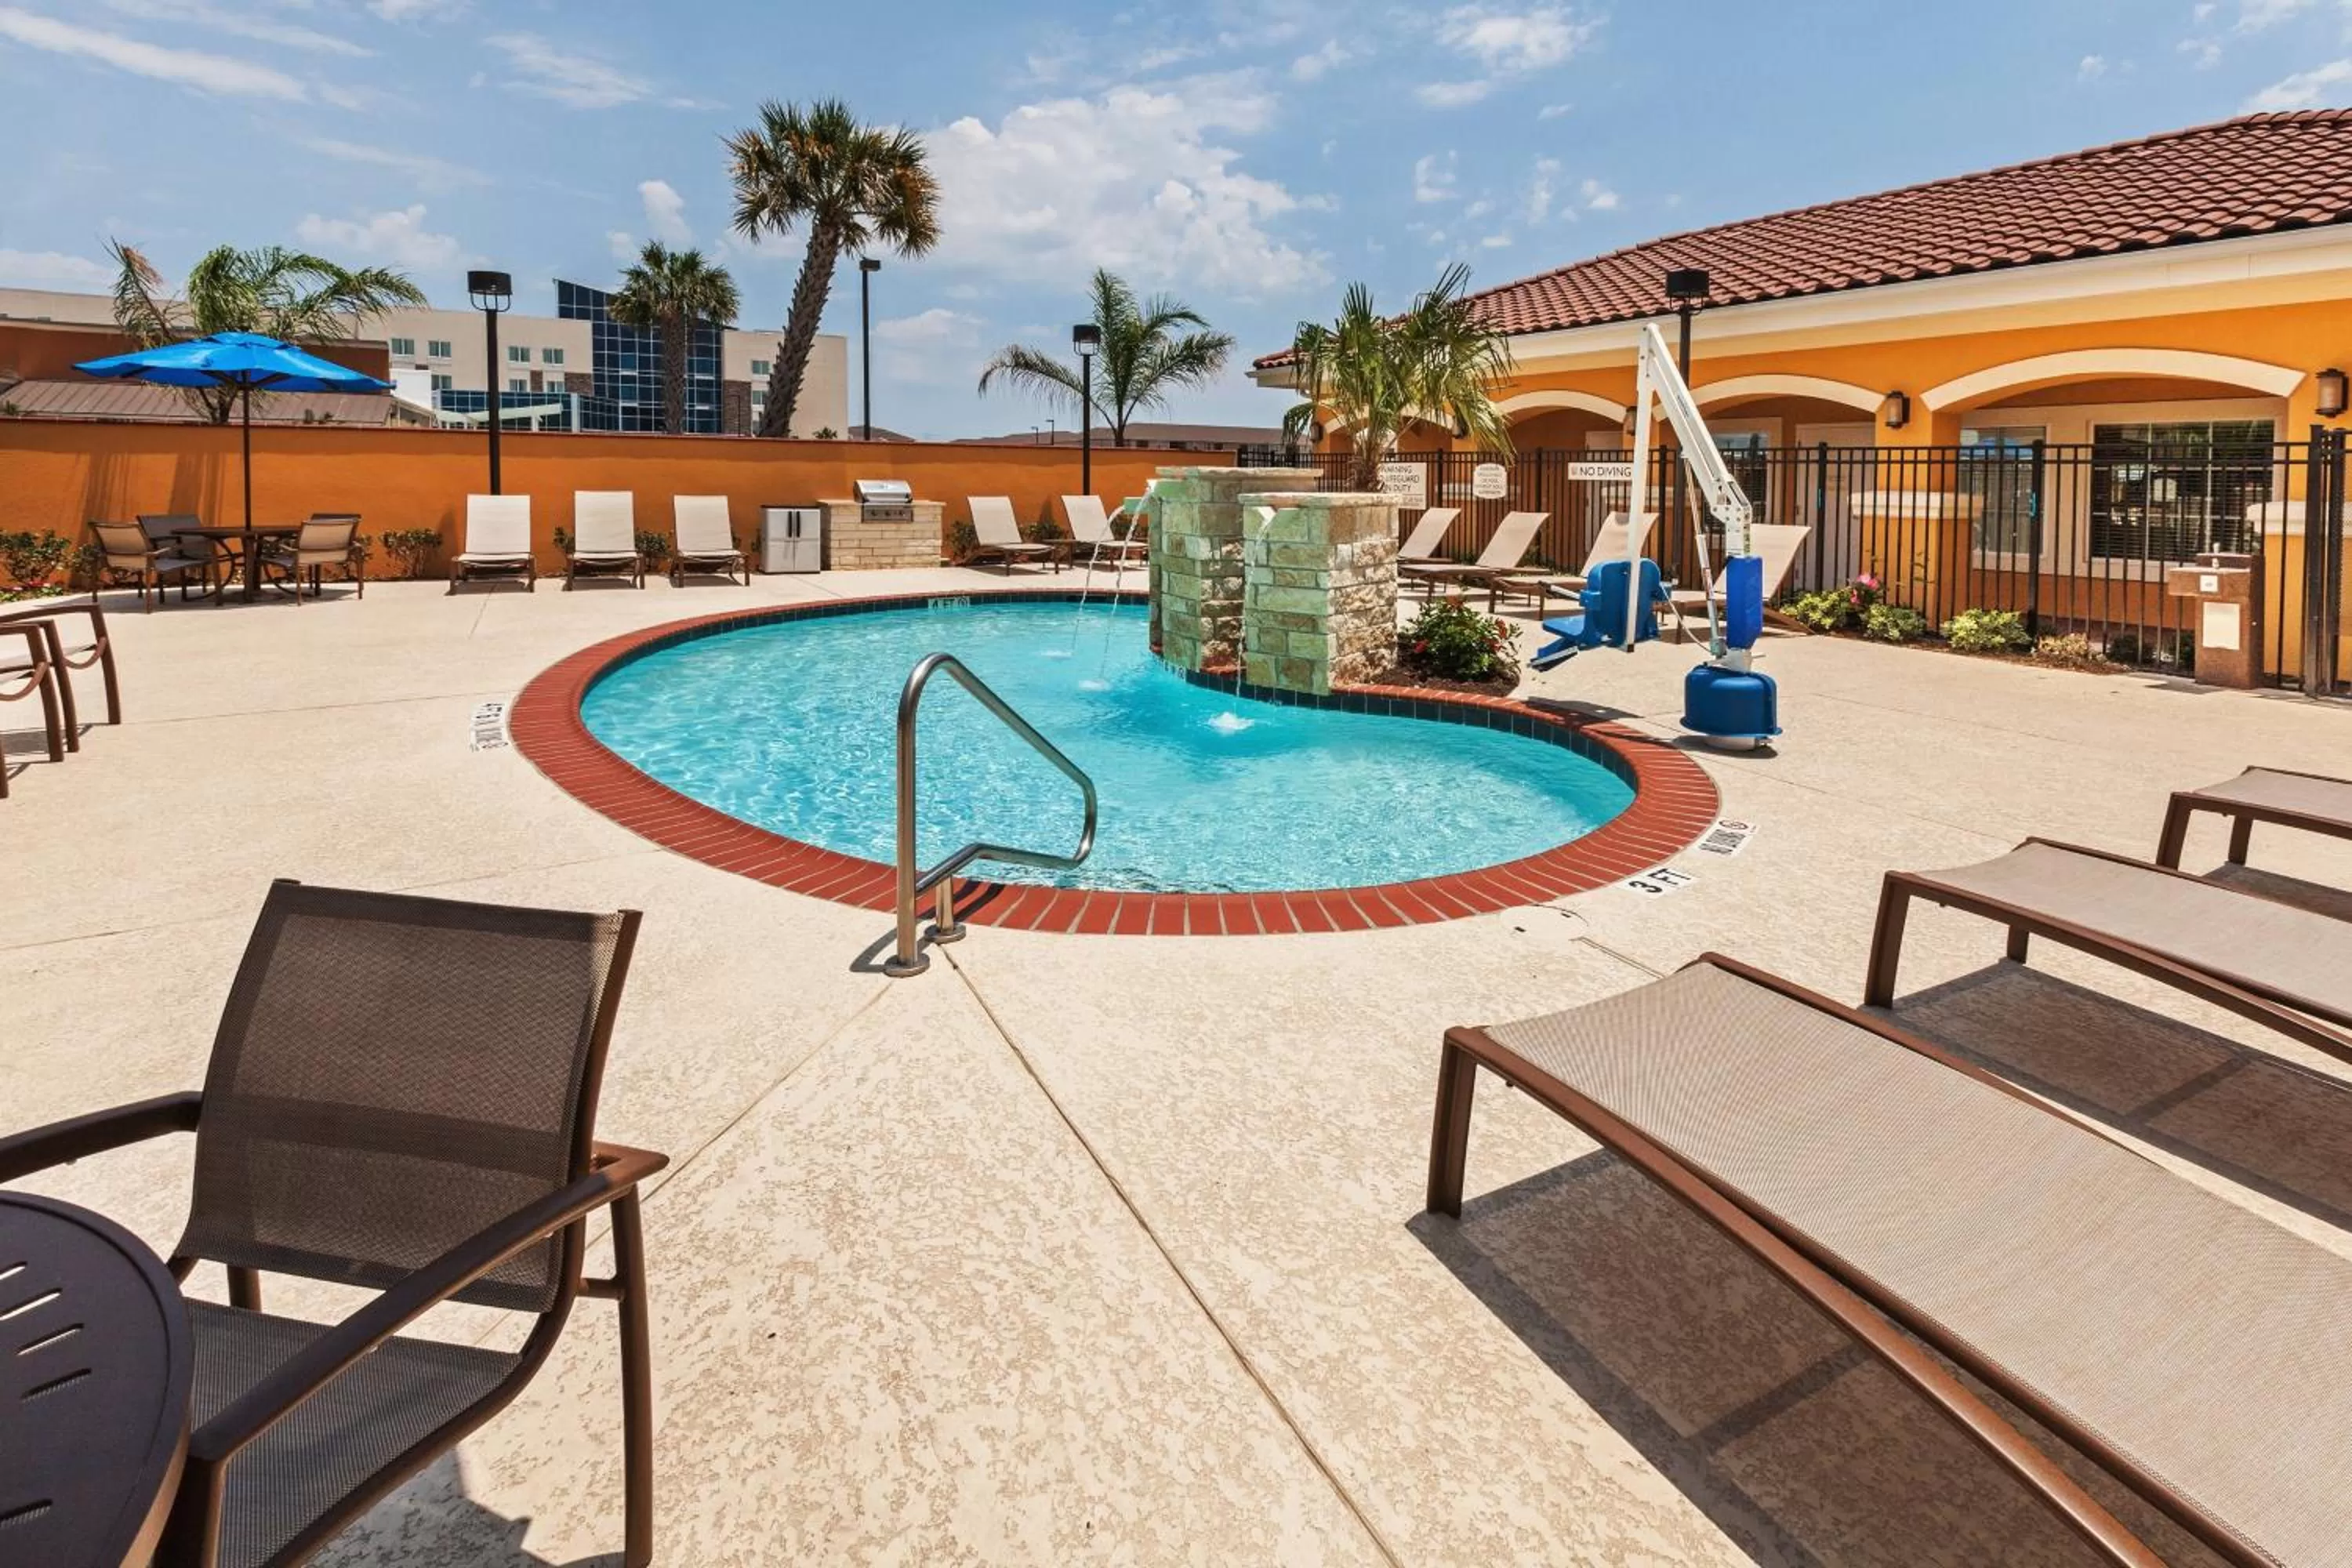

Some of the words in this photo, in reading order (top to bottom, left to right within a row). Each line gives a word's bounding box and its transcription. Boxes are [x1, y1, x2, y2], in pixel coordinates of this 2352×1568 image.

[1580, 466, 1595, 477] NO
[1597, 466, 1632, 477] DIVING
[1628, 880, 1663, 894] 3
[1647, 868, 1691, 885] FT
